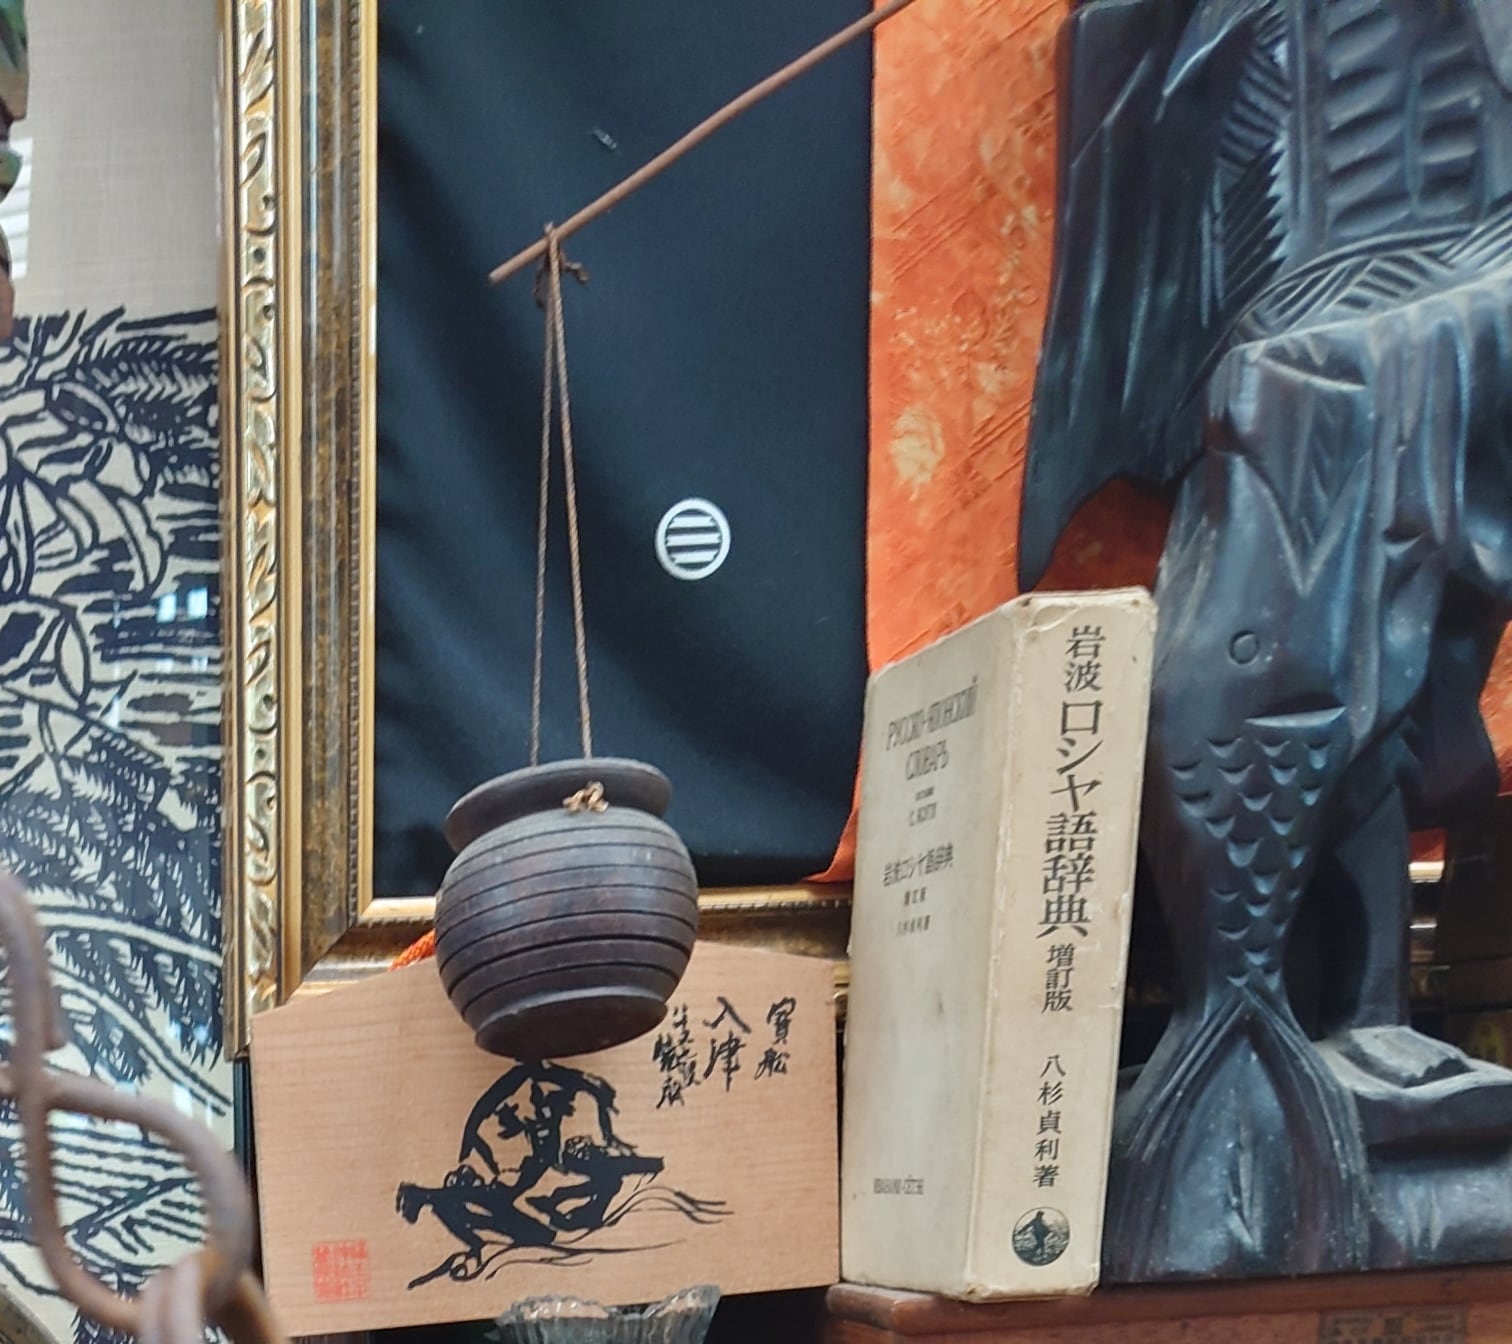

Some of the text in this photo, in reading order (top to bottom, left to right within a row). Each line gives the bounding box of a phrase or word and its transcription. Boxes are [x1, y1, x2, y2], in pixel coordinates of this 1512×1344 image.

[1036, 624, 1106, 1014] 岩波ロシヤ語辞典 増訂版
[1033, 1054, 1066, 1188] 八杉貞利著
